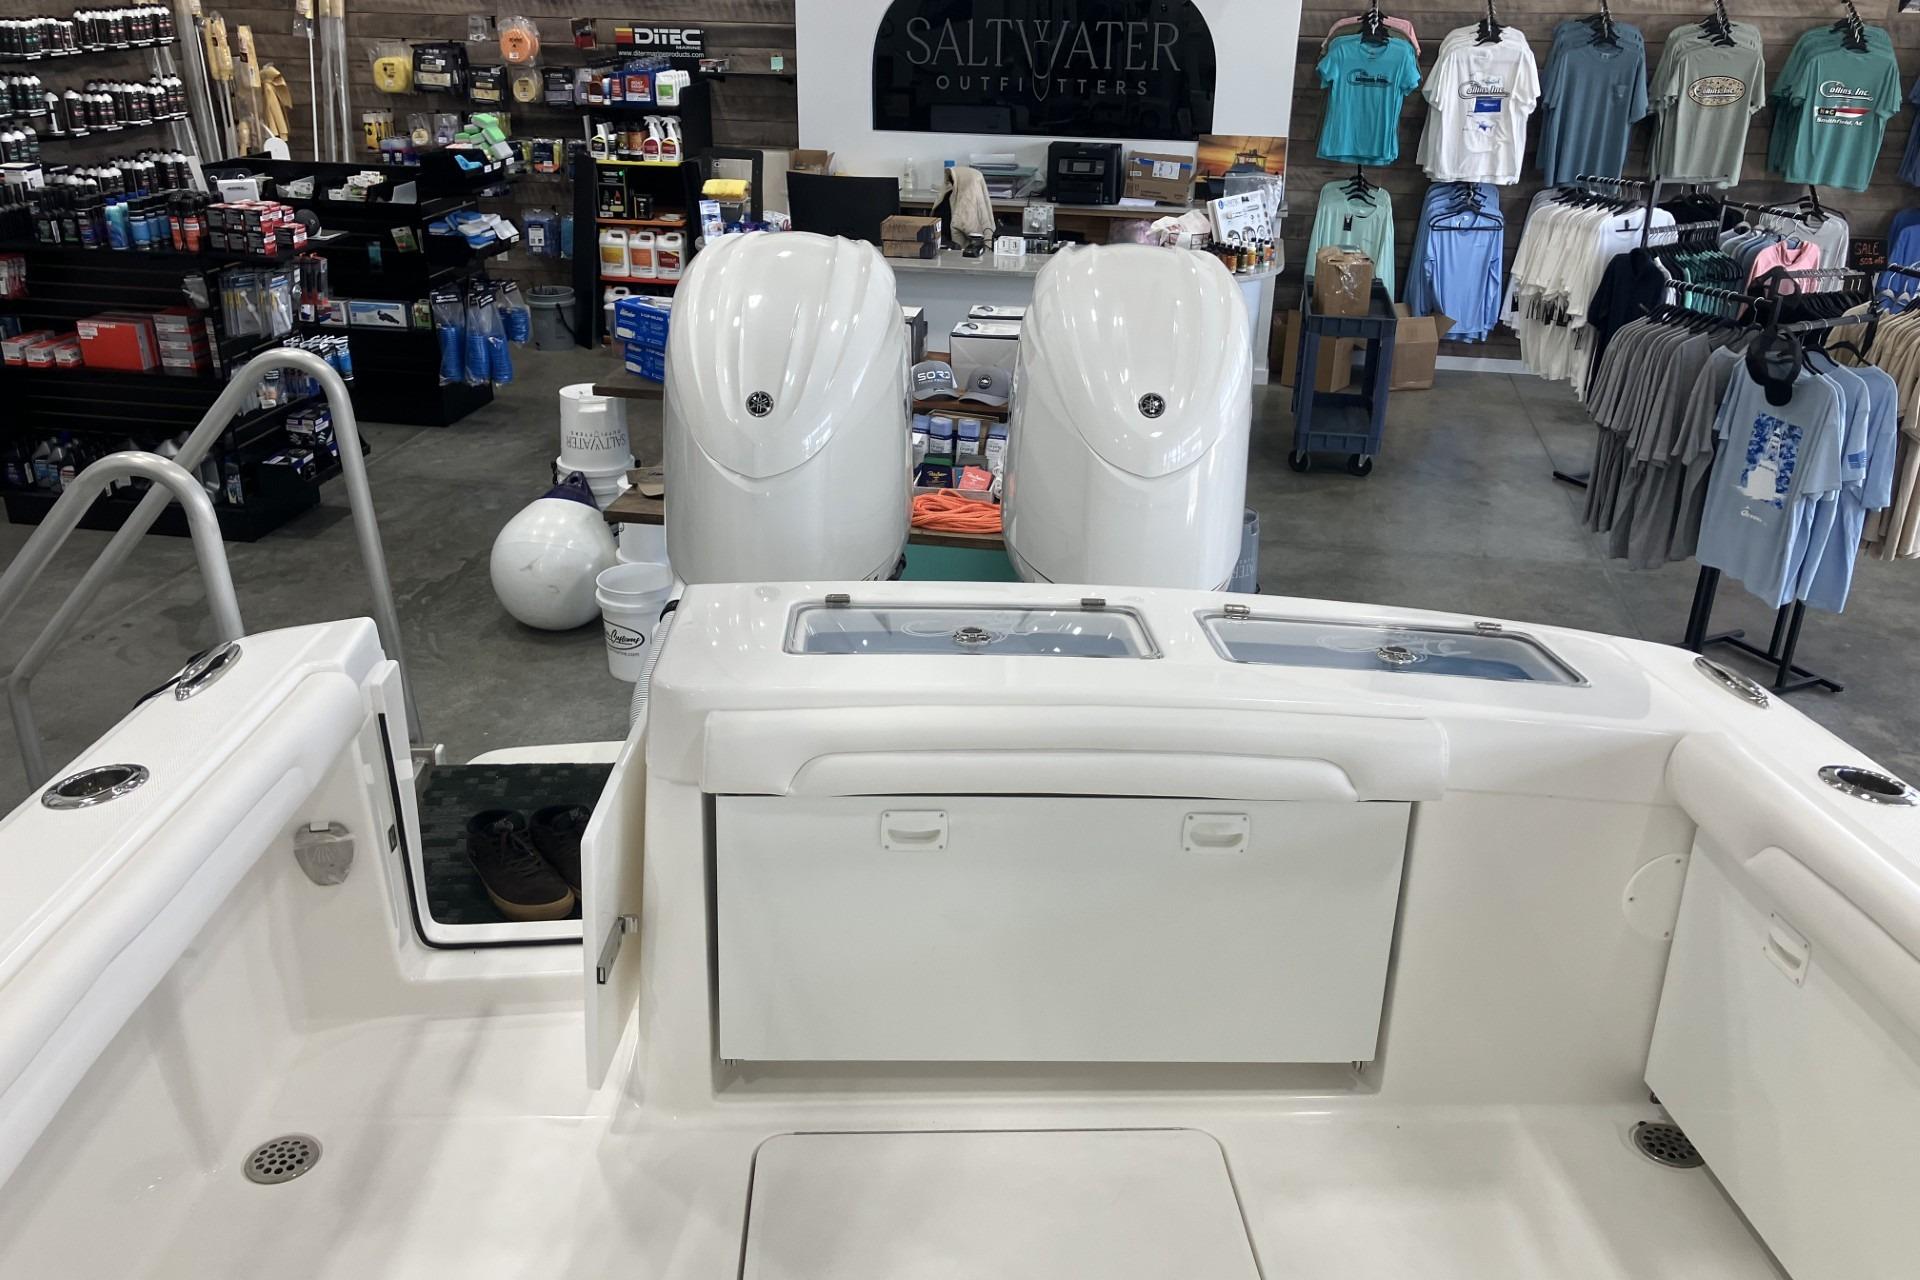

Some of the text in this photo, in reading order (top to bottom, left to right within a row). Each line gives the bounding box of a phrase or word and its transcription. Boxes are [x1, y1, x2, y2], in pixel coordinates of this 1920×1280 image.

[906, 17, 1181, 71] SALTWATER
[936, 75, 1148, 96] OUTFITTERS
[1854, 241, 1880, 255] SALE
[567, 433, 626, 450] SALTWATER
